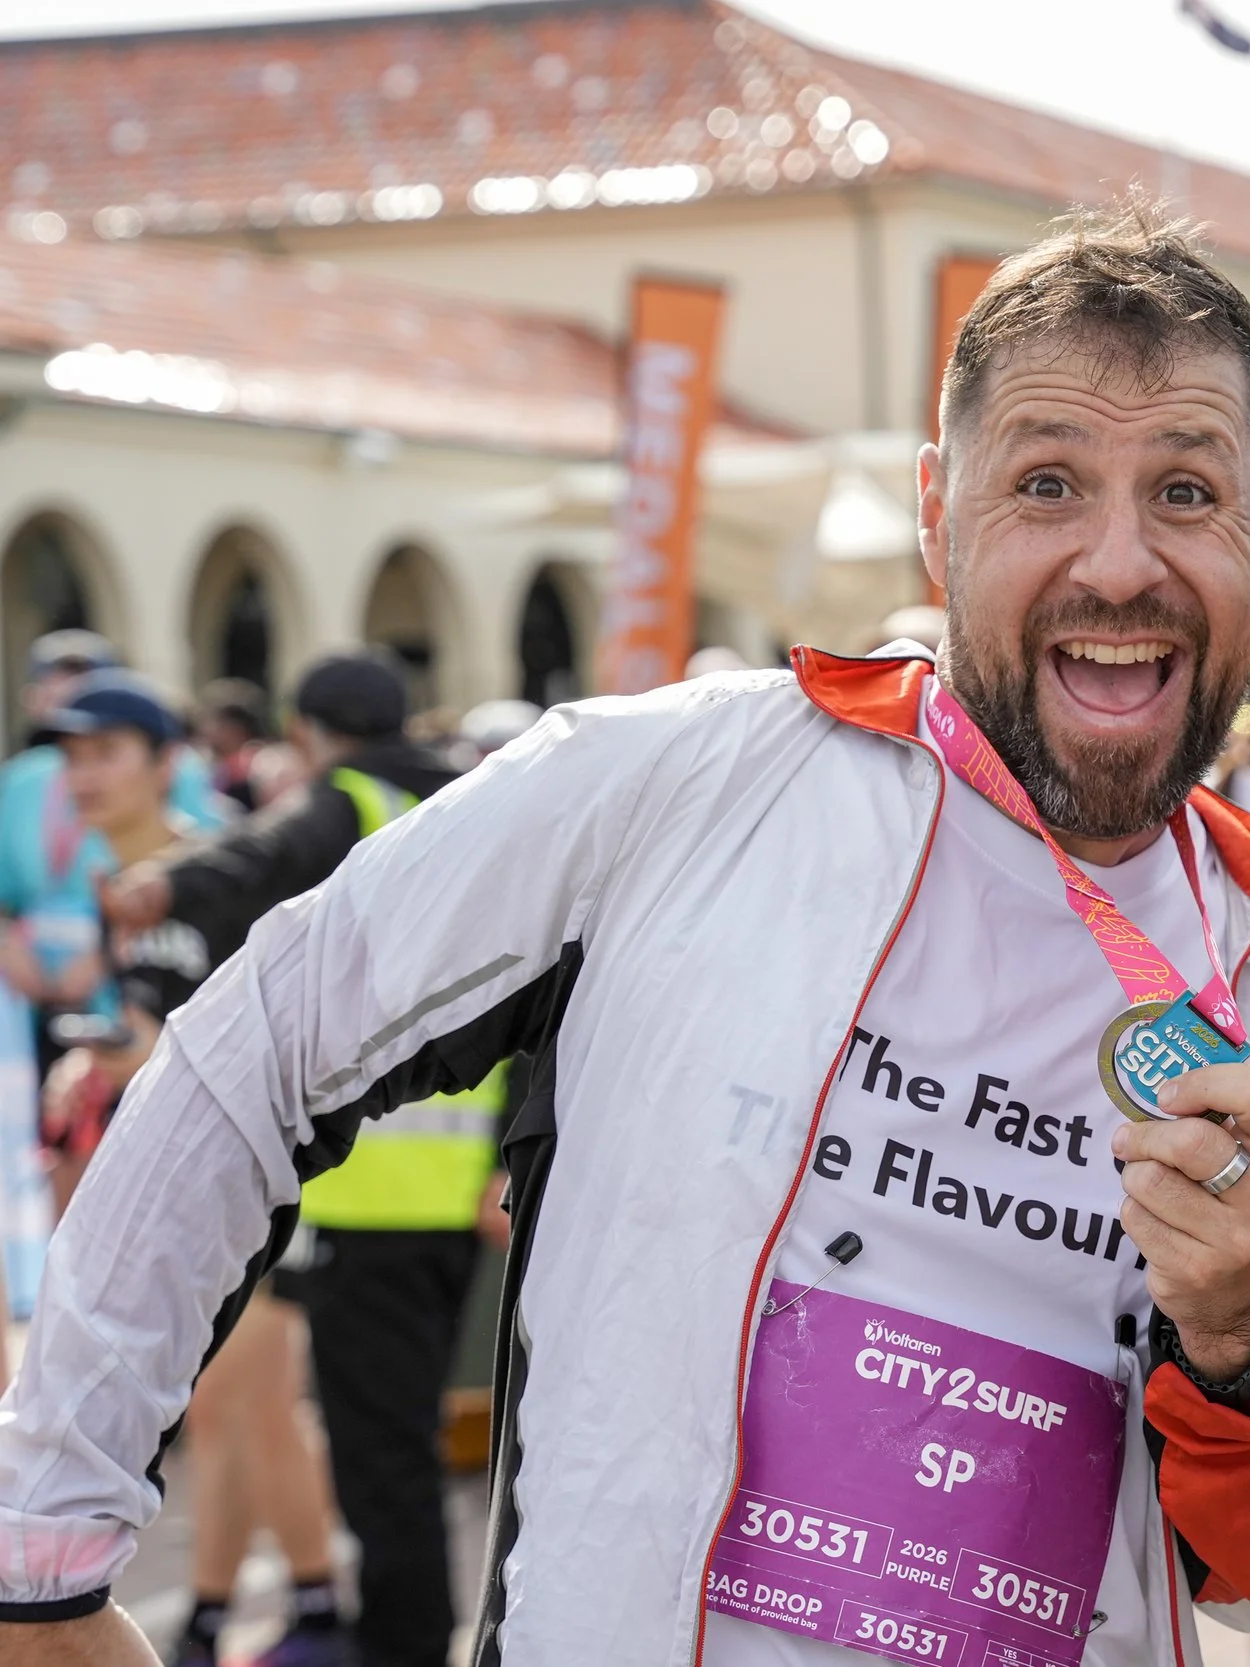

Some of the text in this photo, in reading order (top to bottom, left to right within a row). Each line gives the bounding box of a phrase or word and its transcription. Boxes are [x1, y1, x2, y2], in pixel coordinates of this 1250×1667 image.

[1178, 1032, 1211, 1068] Voltare
[1190, 1022, 1221, 1049] 2026
[963, 1073, 1093, 1167] Fast
[872, 1138, 1147, 1271] Flavour
[884, 1327, 942, 1357] Voltaren
[855, 1348, 1068, 1432] CITY2SURF
[914, 1442, 976, 1493] SP
[739, 1501, 868, 1564] 30531
[900, 1539, 948, 1565] 2026
[707, 1570, 823, 1617] BAG DROP
[886, 1561, 951, 1592] PURPLE
[971, 1564, 1070, 1625] 30531
[720, 1596, 728, 1605] in
[729, 1598, 750, 1611] front
[750, 1604, 760, 1614] of
[761, 1609, 800, 1625] provided
[800, 1616, 818, 1630] bag
[855, 1612, 948, 1660] 30531
[1003, 1648, 1018, 1660] YES
